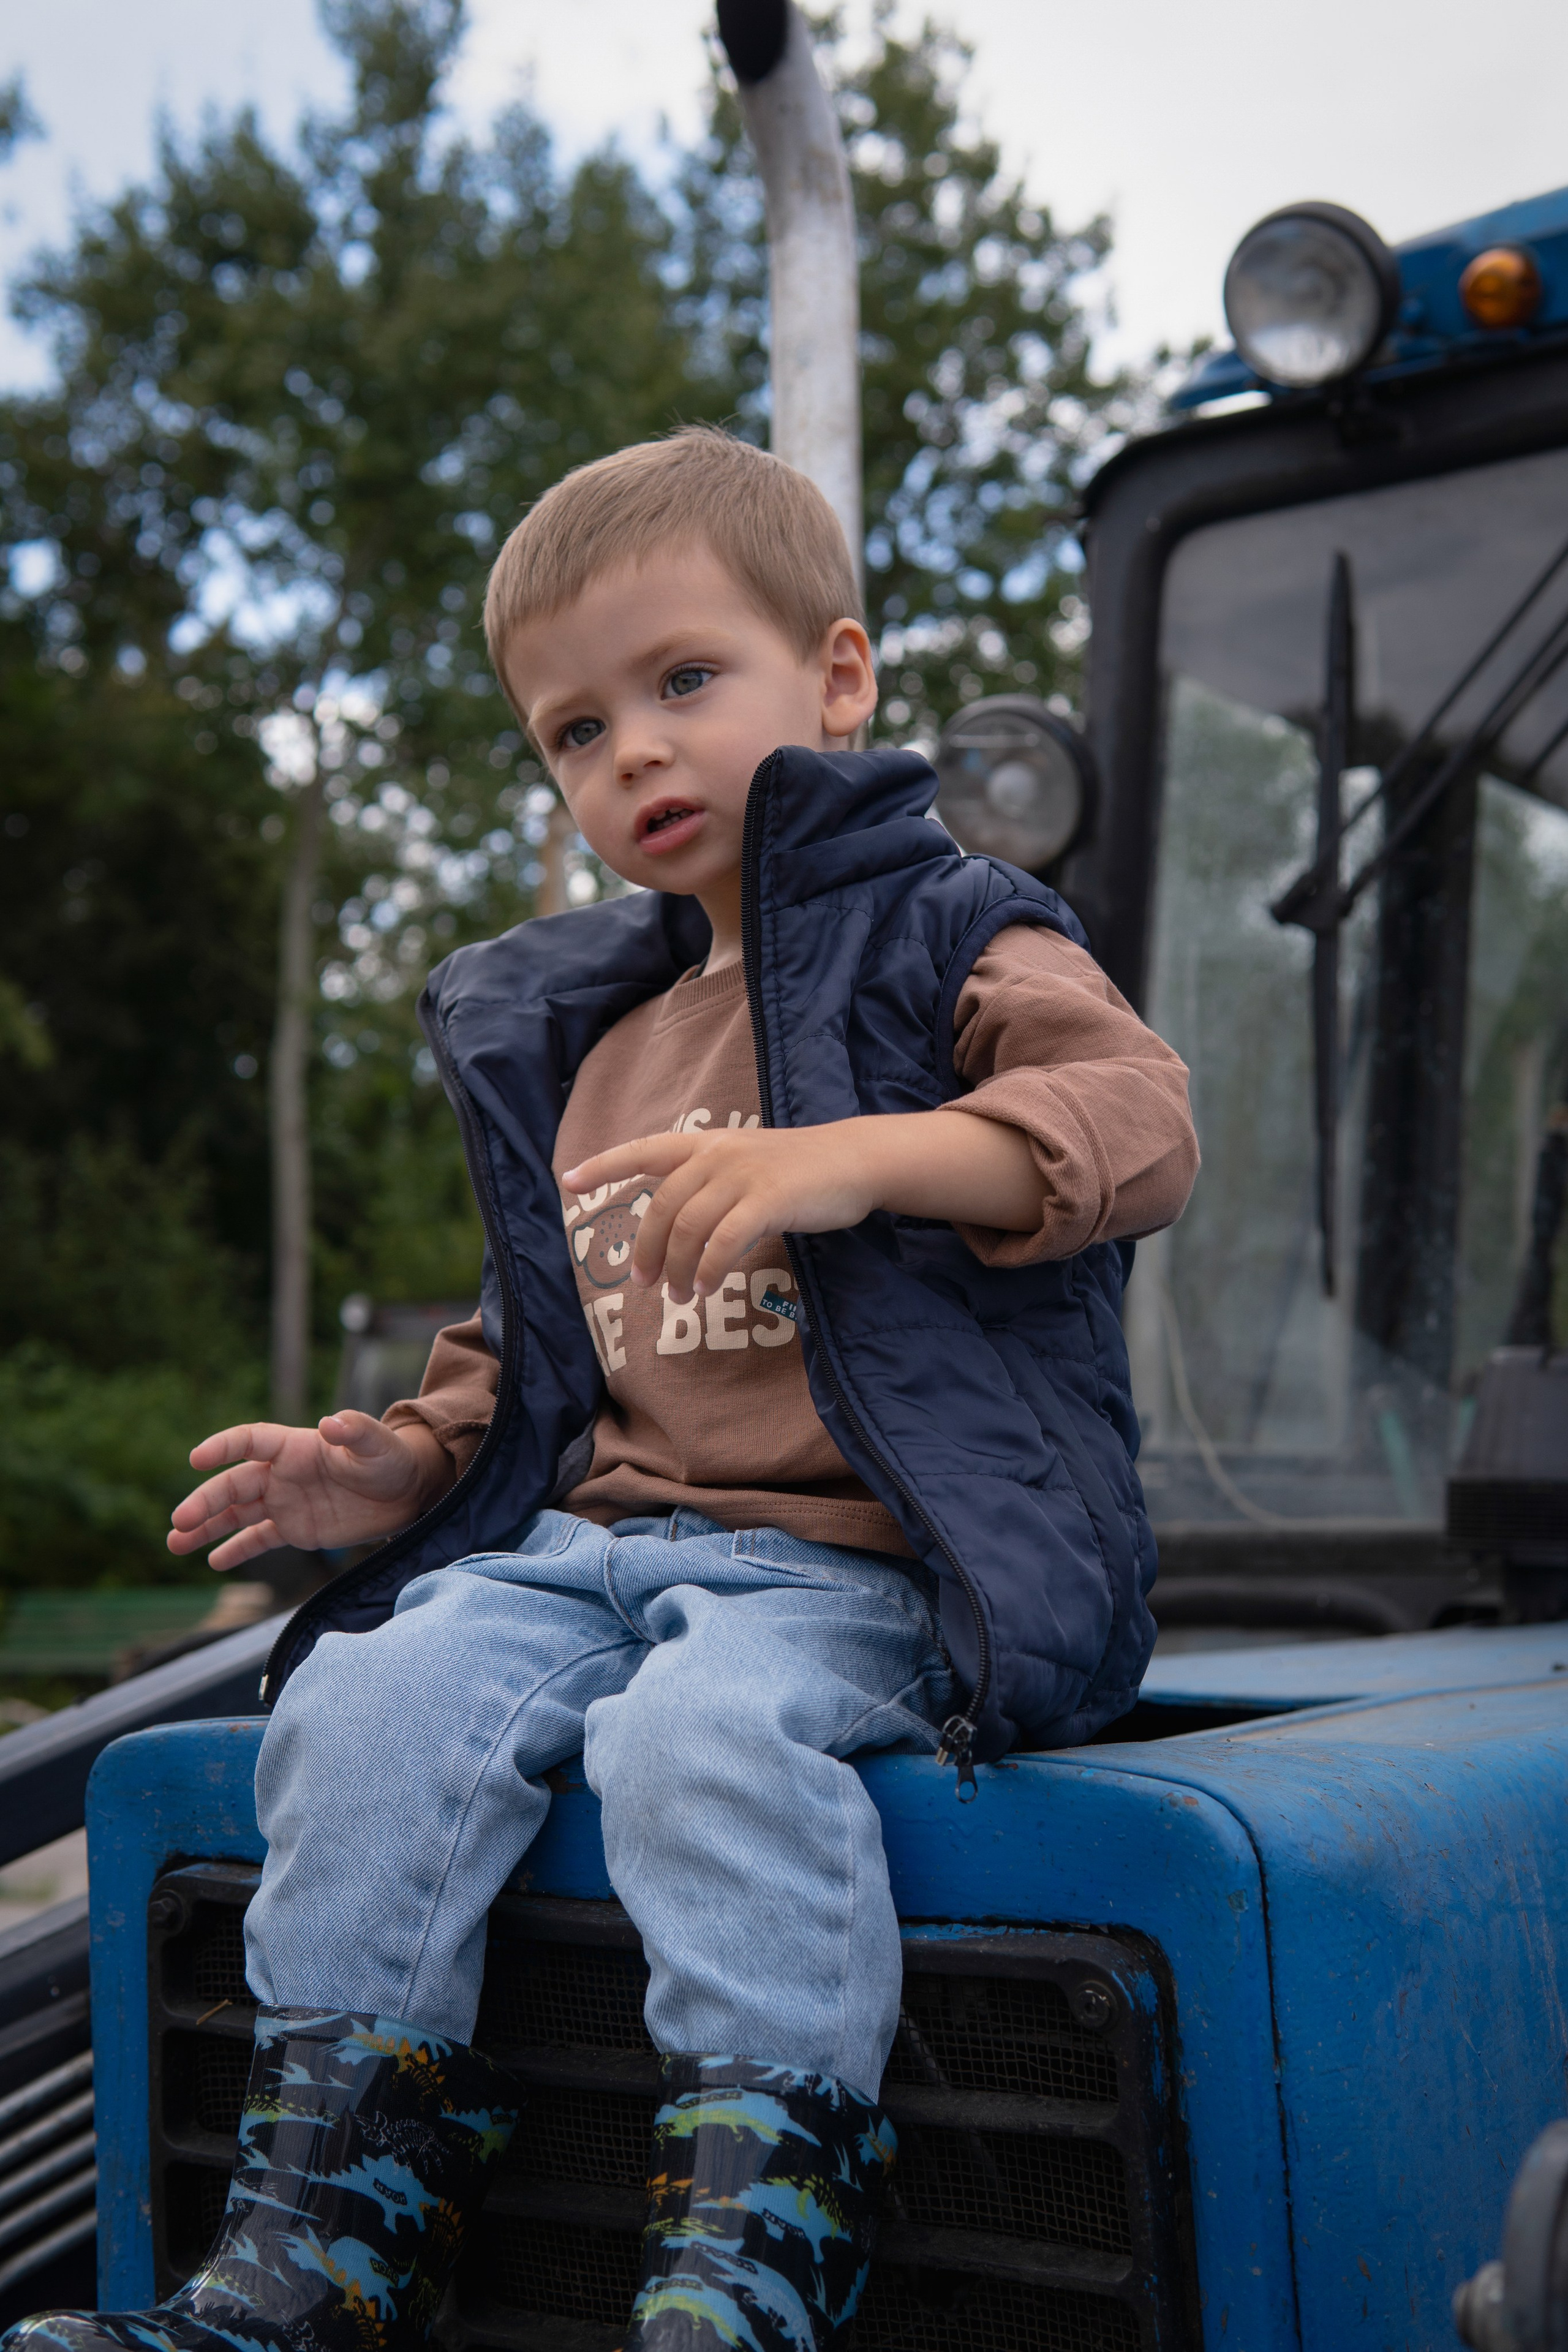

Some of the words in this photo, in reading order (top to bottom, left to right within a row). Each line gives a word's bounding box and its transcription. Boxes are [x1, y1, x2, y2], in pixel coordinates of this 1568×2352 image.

[657, 1268, 798, 1355] BES
[763, 1299, 772, 1308] TO
[775, 1305, 787, 1314] BE
[789, 1311, 797, 1320] B
[373, 2178, 407, 2205] ROAR
